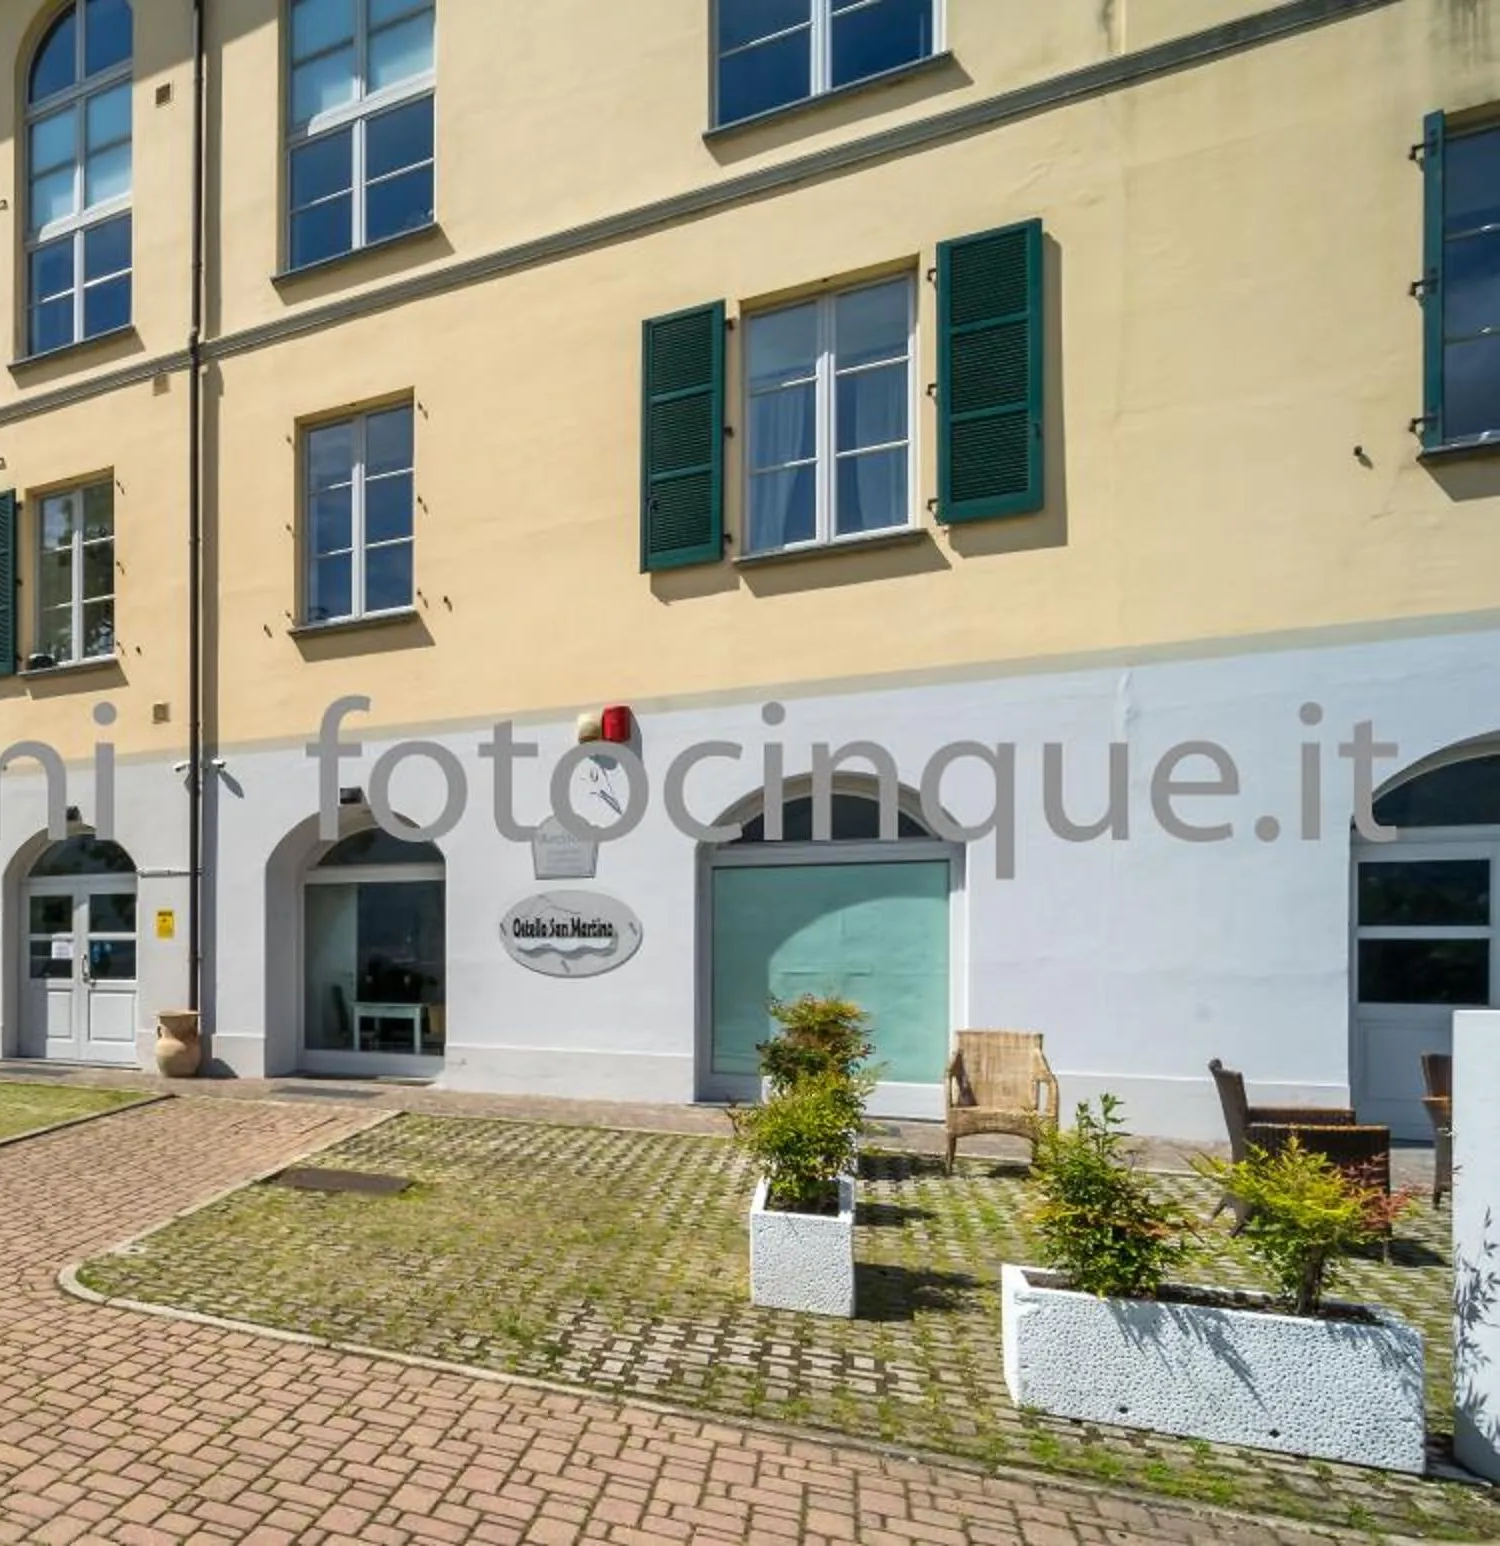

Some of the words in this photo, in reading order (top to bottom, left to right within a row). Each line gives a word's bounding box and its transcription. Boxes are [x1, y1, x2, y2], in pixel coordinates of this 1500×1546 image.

[513, 918, 547, 938] Ostello
[549, 917, 569, 937] San
[571, 917, 613, 938] Martino
